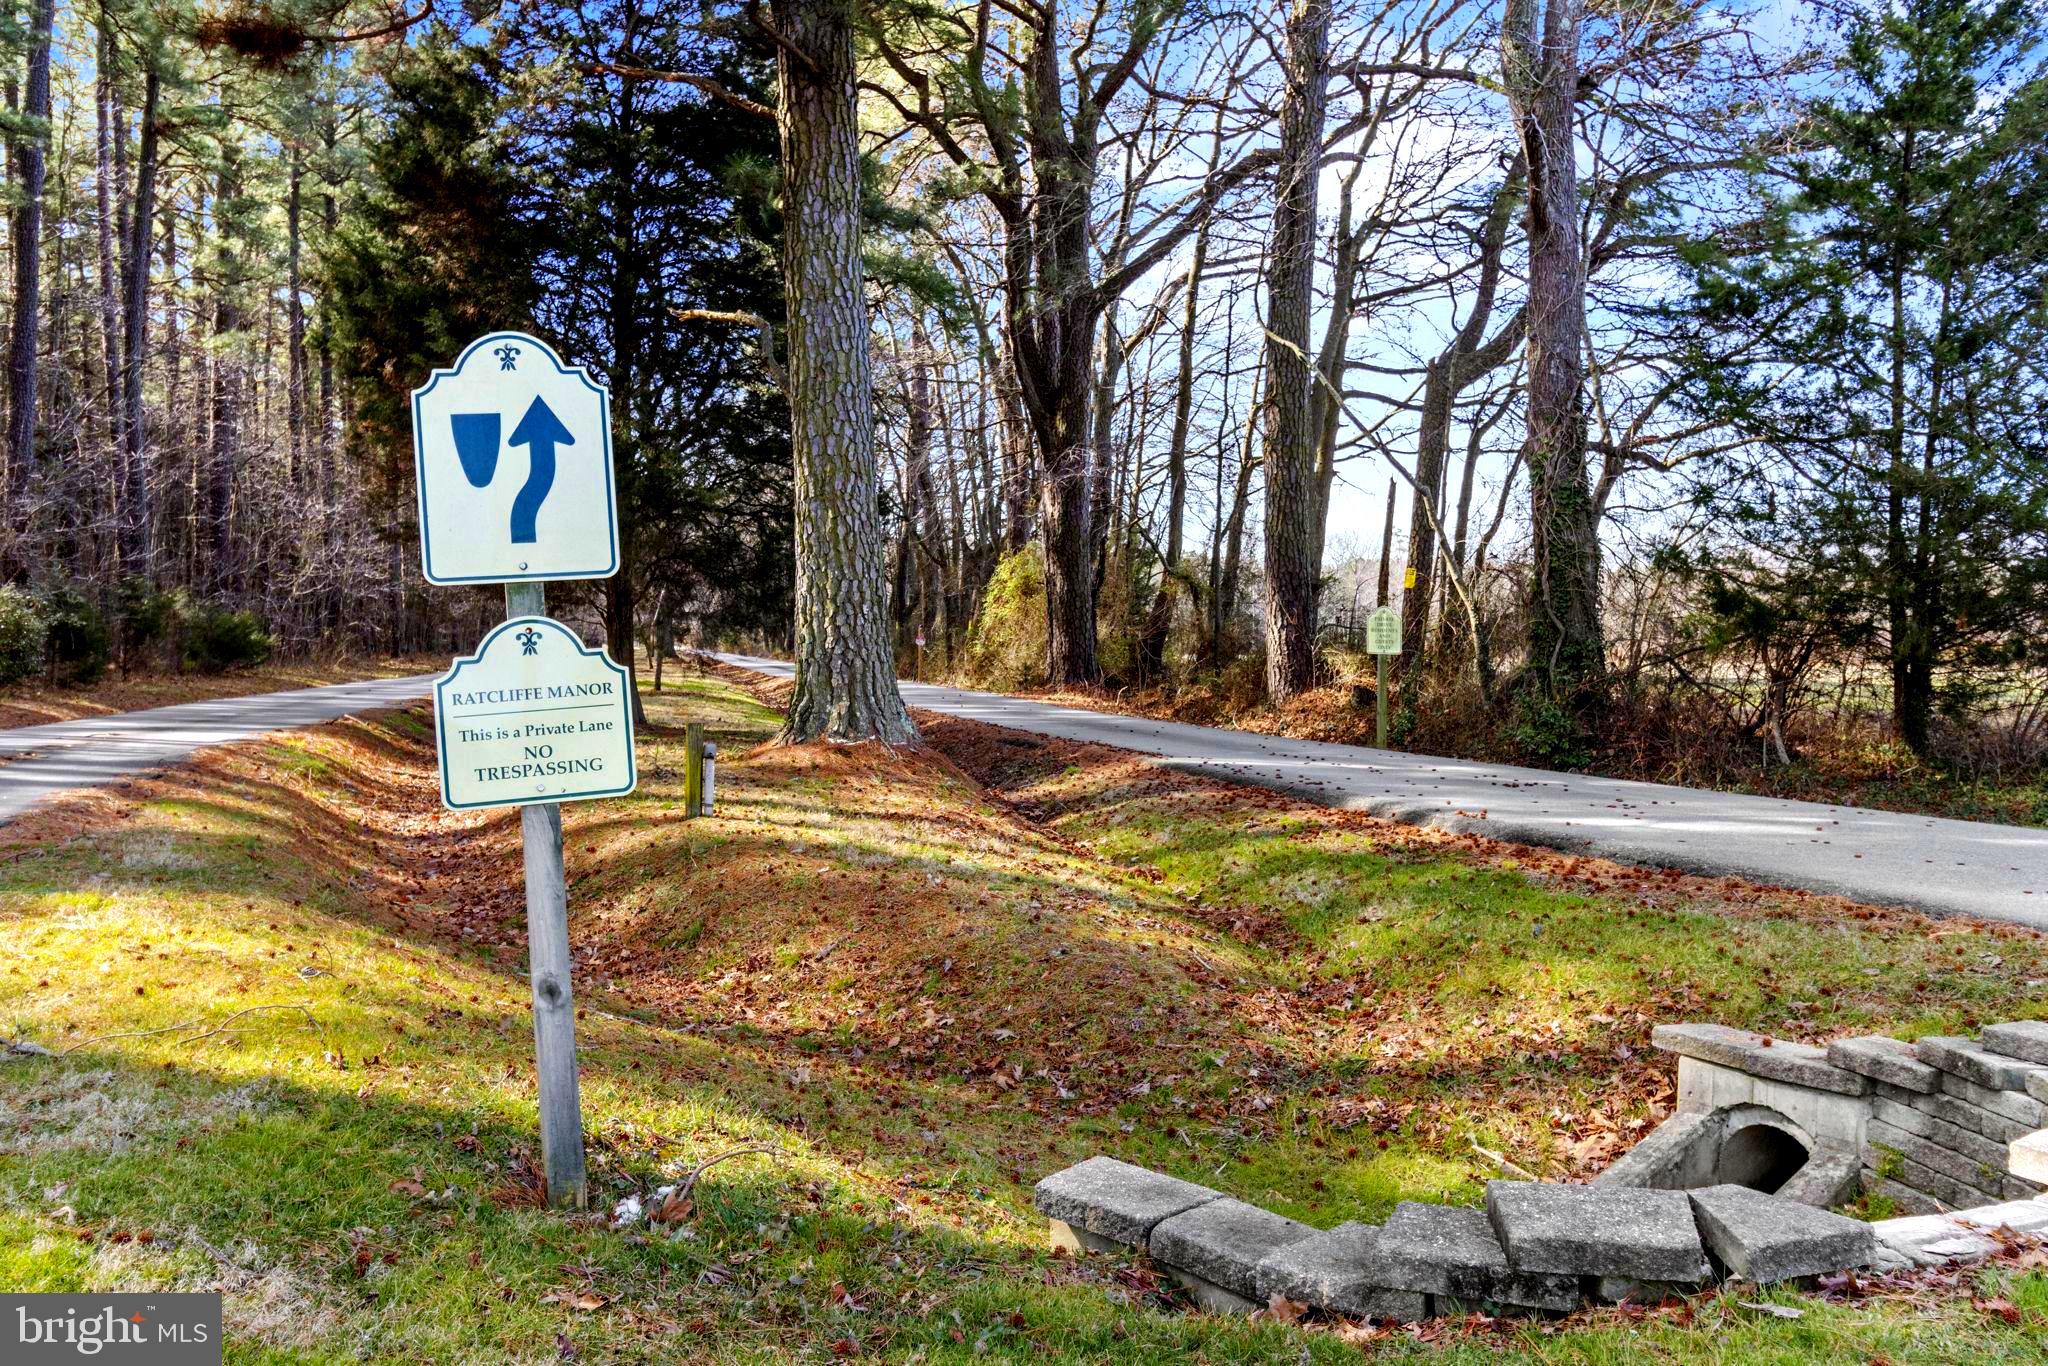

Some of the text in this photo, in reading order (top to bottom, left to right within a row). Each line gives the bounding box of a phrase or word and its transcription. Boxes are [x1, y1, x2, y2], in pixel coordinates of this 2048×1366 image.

[451, 682, 614, 706] RATCLIFFE MANOR
[458, 720, 613, 743] This is a Private Lane
[524, 744, 553, 760] NO
[474, 758, 603, 782] TRESPASSING
